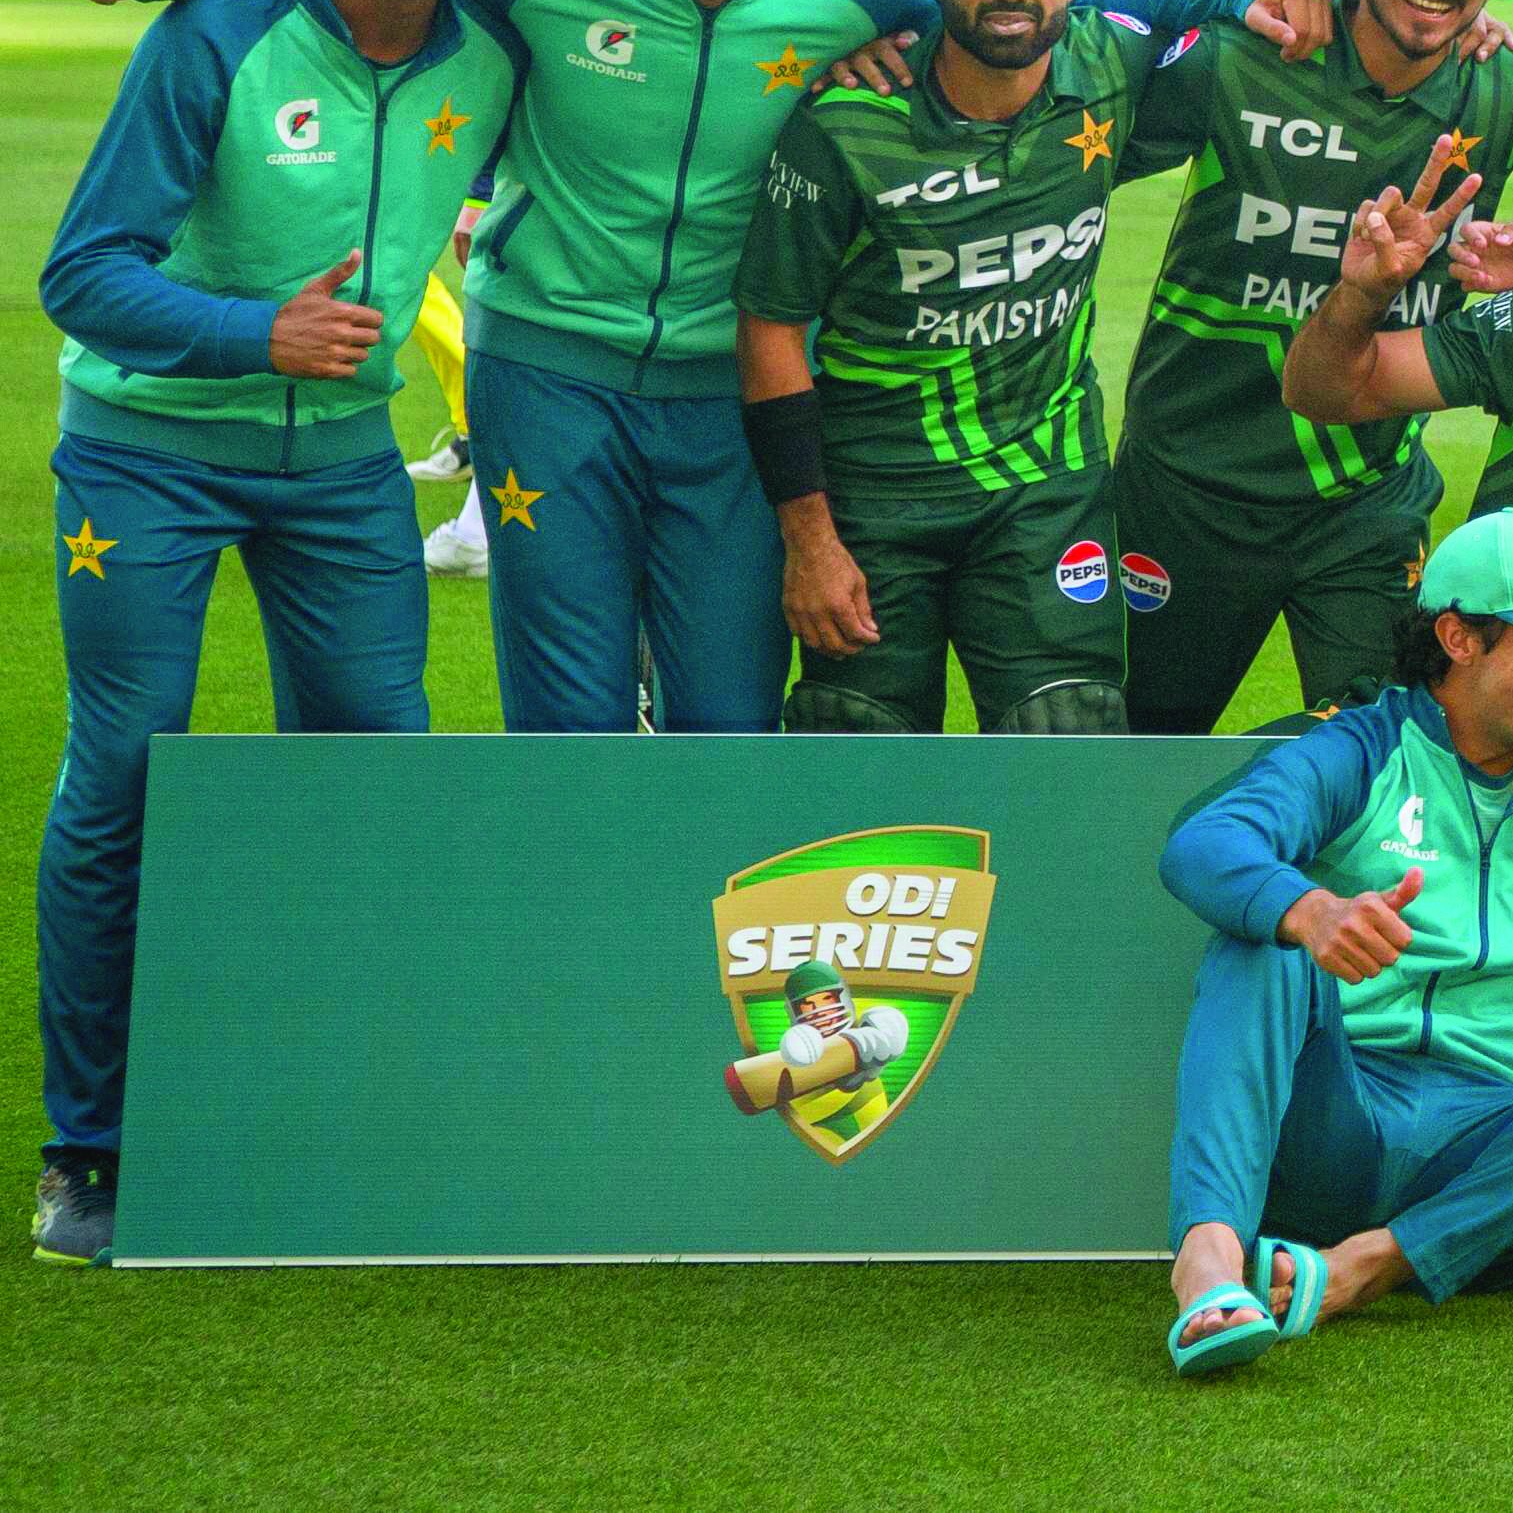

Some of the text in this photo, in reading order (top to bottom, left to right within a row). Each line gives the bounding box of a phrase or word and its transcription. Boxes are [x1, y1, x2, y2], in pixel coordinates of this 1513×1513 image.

[566, 52, 646, 83] GATORADE
[266, 150, 337, 165] GATORADE
[1240, 110, 1358, 162] TCL
[876, 162, 1000, 208] TCL
[1241, 273, 1441, 327] PAKAN
[1059, 563, 1106, 583] PEPSI
[1120, 565, 1169, 596] PEPSI
[846, 873, 958, 919] ODI
[727, 922, 978, 978] SERIES
